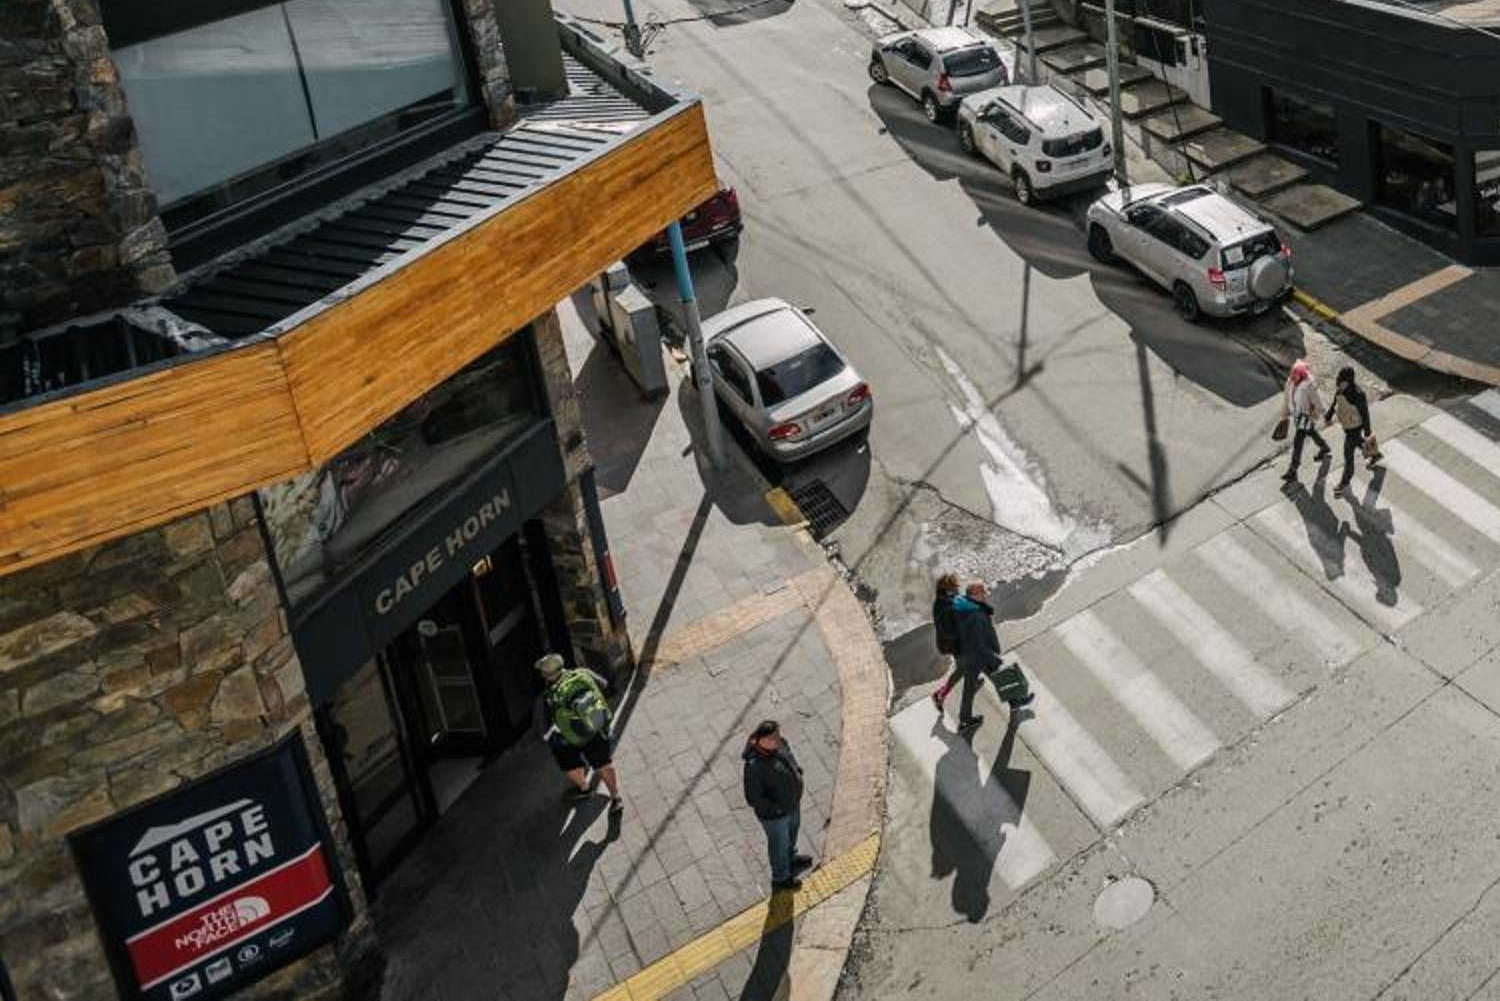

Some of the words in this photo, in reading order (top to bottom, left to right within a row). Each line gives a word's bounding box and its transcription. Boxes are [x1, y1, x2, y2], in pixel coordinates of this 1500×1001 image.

[375, 546, 444, 615] CAPE
[445, 488, 511, 556] HORN
[129, 804, 269, 887] CAPE
[137, 832, 275, 917] HORN
[175, 911, 239, 951] NORTH
